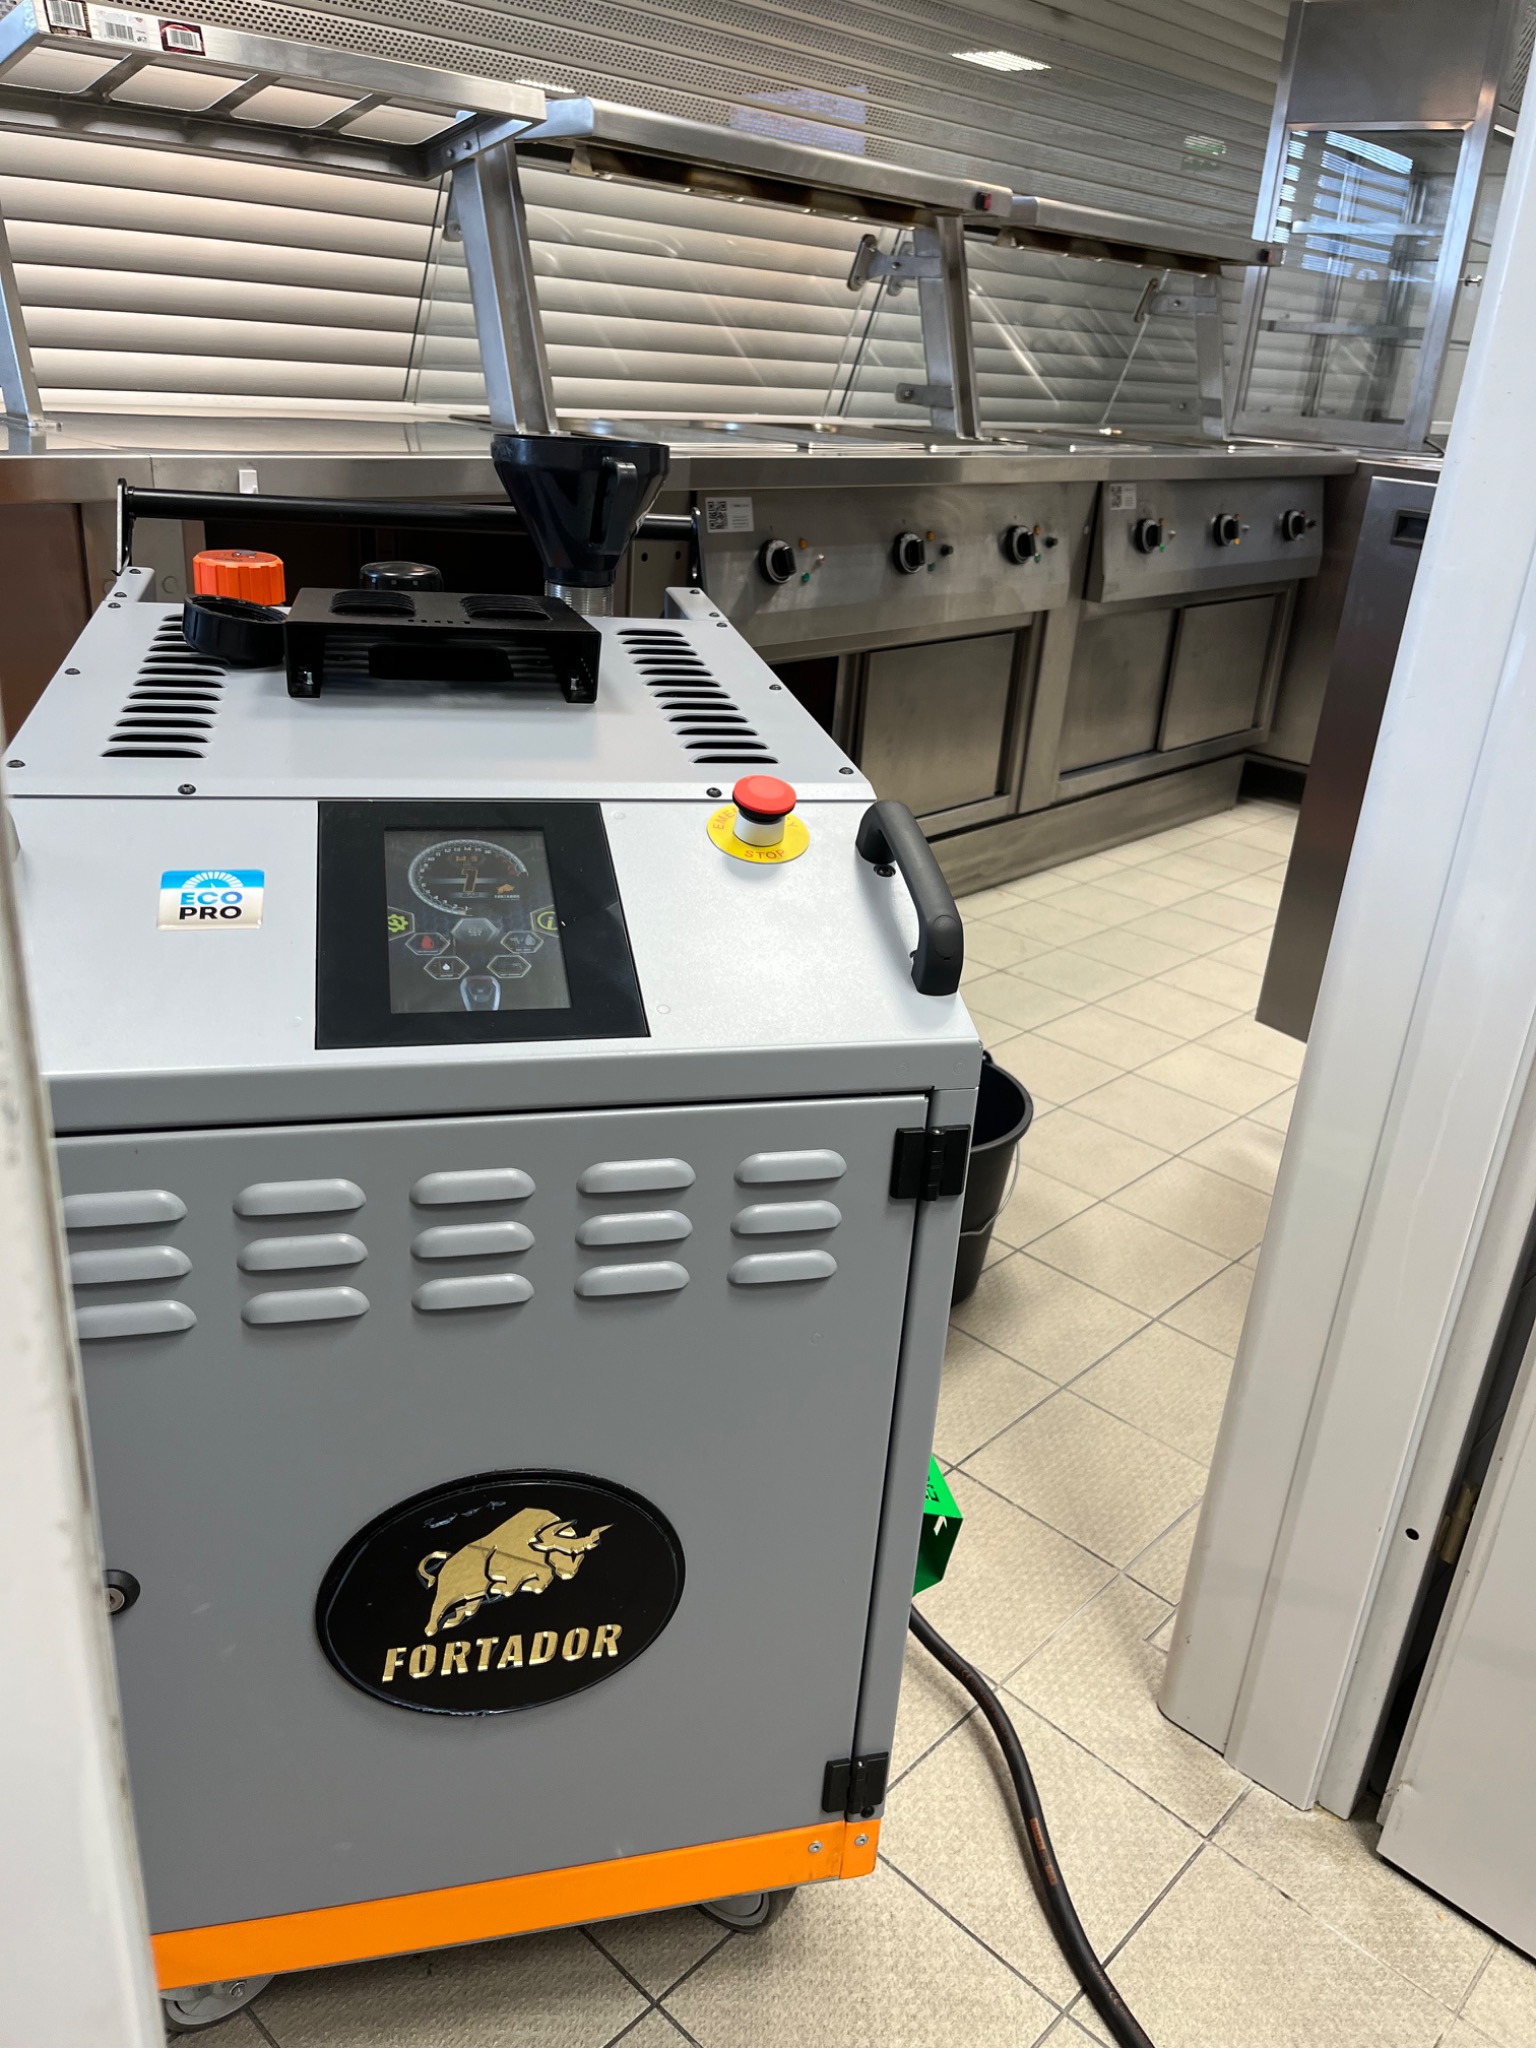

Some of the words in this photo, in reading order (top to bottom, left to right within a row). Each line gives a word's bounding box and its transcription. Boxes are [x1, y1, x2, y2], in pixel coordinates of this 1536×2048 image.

[744, 849, 785, 859] STOP
[180, 891, 243, 905] ECO
[179, 905, 242, 920] PRO
[382, 1624, 622, 1682] FORTADOR
